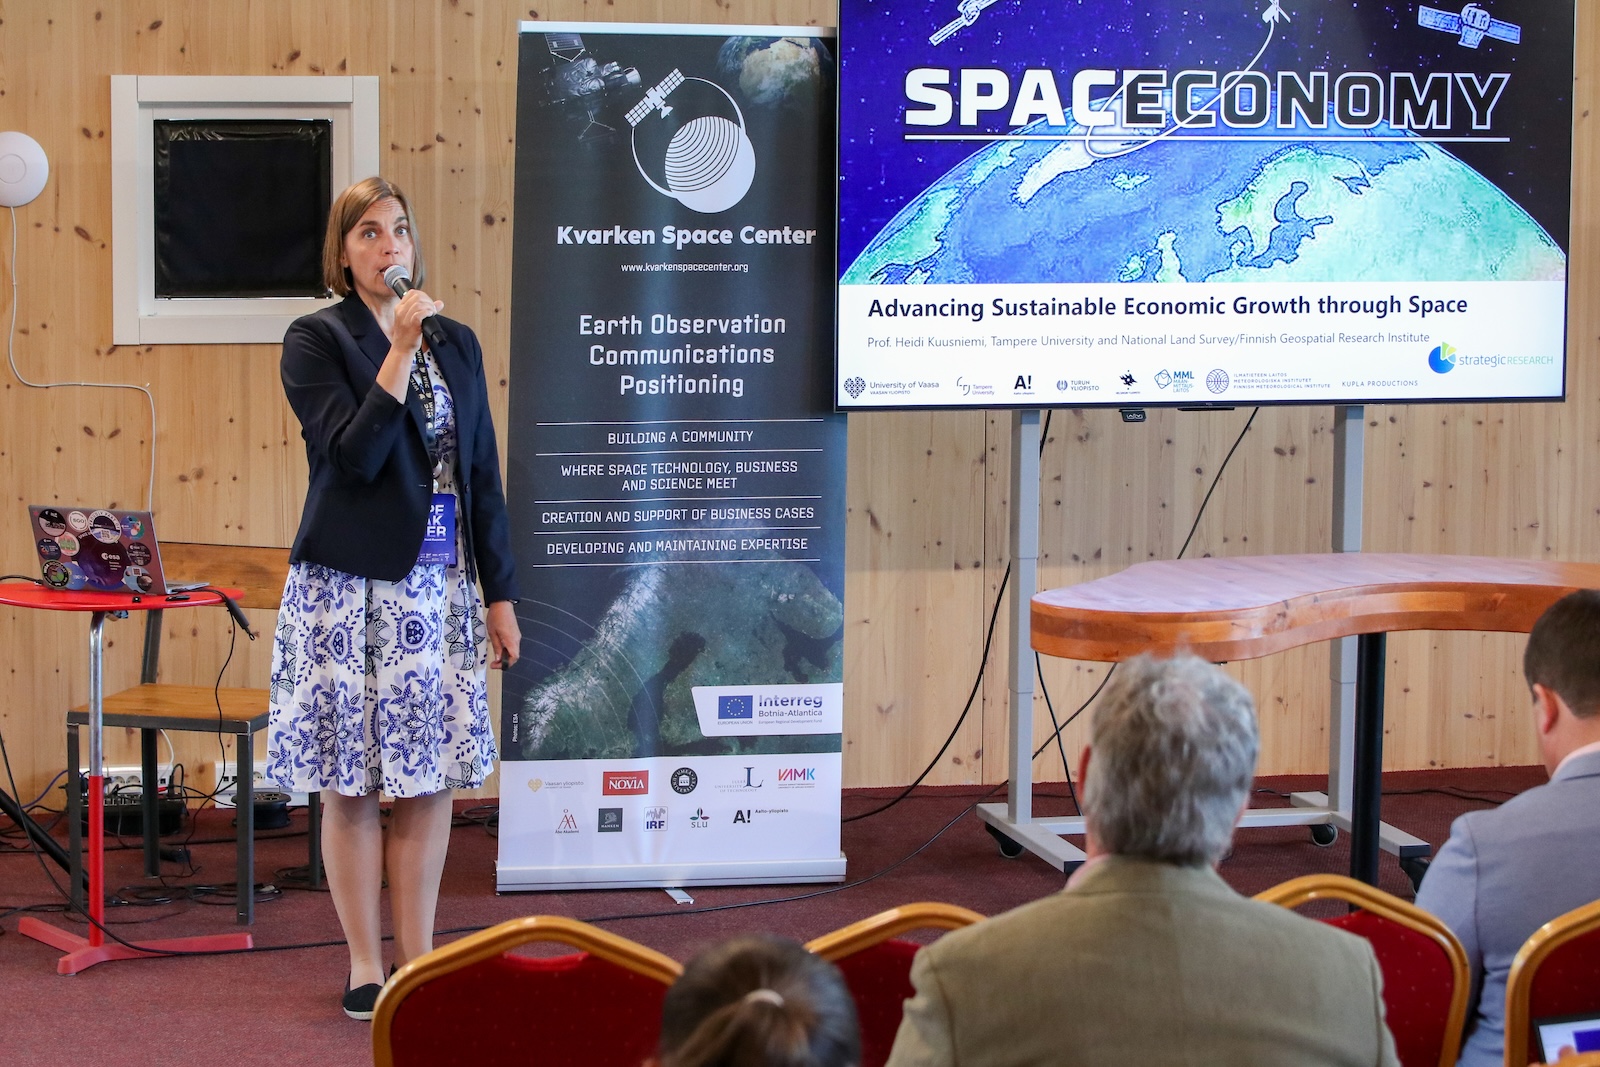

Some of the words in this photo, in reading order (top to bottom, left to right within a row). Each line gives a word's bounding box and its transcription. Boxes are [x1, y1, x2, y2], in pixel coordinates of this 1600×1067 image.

[904, 68, 1511, 130] SPACECONOMY
[556, 225, 656, 245] Kvarken
[662, 225, 734, 250] Space
[739, 225, 817, 245] Center
[620, 262, 749, 273] www.kvarkenspacecenter.org
[868, 298, 984, 322] Advancing
[992, 297, 1116, 317] Sustainable
[1124, 296, 1226, 316] Economic
[1232, 296, 1310, 315] Growth
[1318, 295, 1402, 319] through
[1408, 296, 1468, 318] Space
[579, 314, 642, 336] Earth
[651, 314, 786, 334] Observation
[867, 336, 892, 348] Prof.
[895, 336, 924, 348] Heidi
[928, 335, 988, 348] Kuusniemi,
[990, 335, 1038, 349] Tampere
[1041, 335, 1094, 349] University
[1097, 335, 1118, 346] and
[1121, 334, 1167, 346] National
[1170, 334, 1196, 345] Land
[1199, 332, 1277, 346] Survey/Finnish
[1280, 332, 1335, 346] Geospatial
[1338, 332, 1385, 344] Research
[1388, 331, 1430, 343] Institute
[589, 343, 774, 366] Communications
[1014, 375, 1032, 390] A!
[1174, 371, 1194, 380] MML
[620, 374, 744, 397] Positioning
[870, 382, 906, 390] University
[608, 431, 666, 445] BUILDING
[670, 431, 678, 442] A
[682, 430, 754, 443] COMMUNITY
[561, 464, 604, 476] WHERE
[608, 463, 647, 476] SPACE
[651, 462, 732, 475] TECHNOLOGY,
[735, 461, 798, 473] BUSINESS
[622, 479, 646, 491] AND
[650, 478, 702, 490] SCIENCE
[706, 477, 738, 489] MEET
[542, 511, 601, 524] CREATION
[605, 510, 630, 523] AND
[634, 509, 688, 522] SUPPORT
[691, 508, 707, 520] OF
[710, 508, 771, 520] BUSINESS
[775, 507, 814, 519] CASES
[547, 542, 624, 555] DEVELOPING
[628, 541, 652, 554] AND
[655, 539, 737, 552] MAINTAINING
[741, 538, 808, 551] EXPERTISE
[759, 695, 823, 708] Interreg
[759, 709, 822, 718] Botnia-Atlantica
[609, 779, 644, 790] NOVIA
[733, 810, 751, 824] A!
[646, 821, 665, 829] IRF
